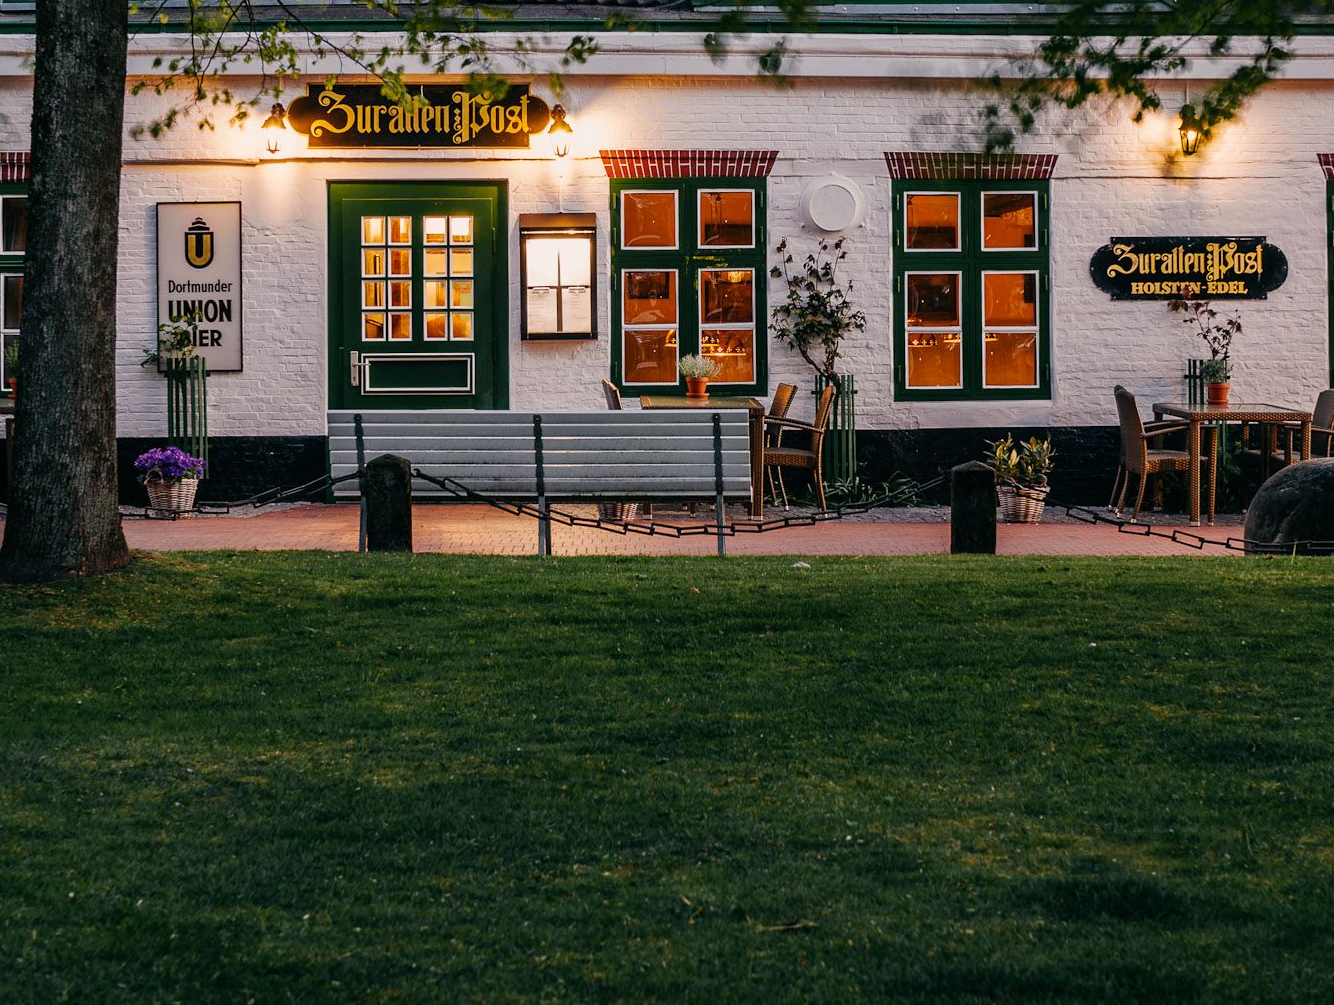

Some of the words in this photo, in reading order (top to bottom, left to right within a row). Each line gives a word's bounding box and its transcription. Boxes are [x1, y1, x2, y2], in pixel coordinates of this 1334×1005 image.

[168, 279, 233, 293] Dortmunder
[168, 300, 232, 323] UNION
[179, 329, 222, 346] IER
